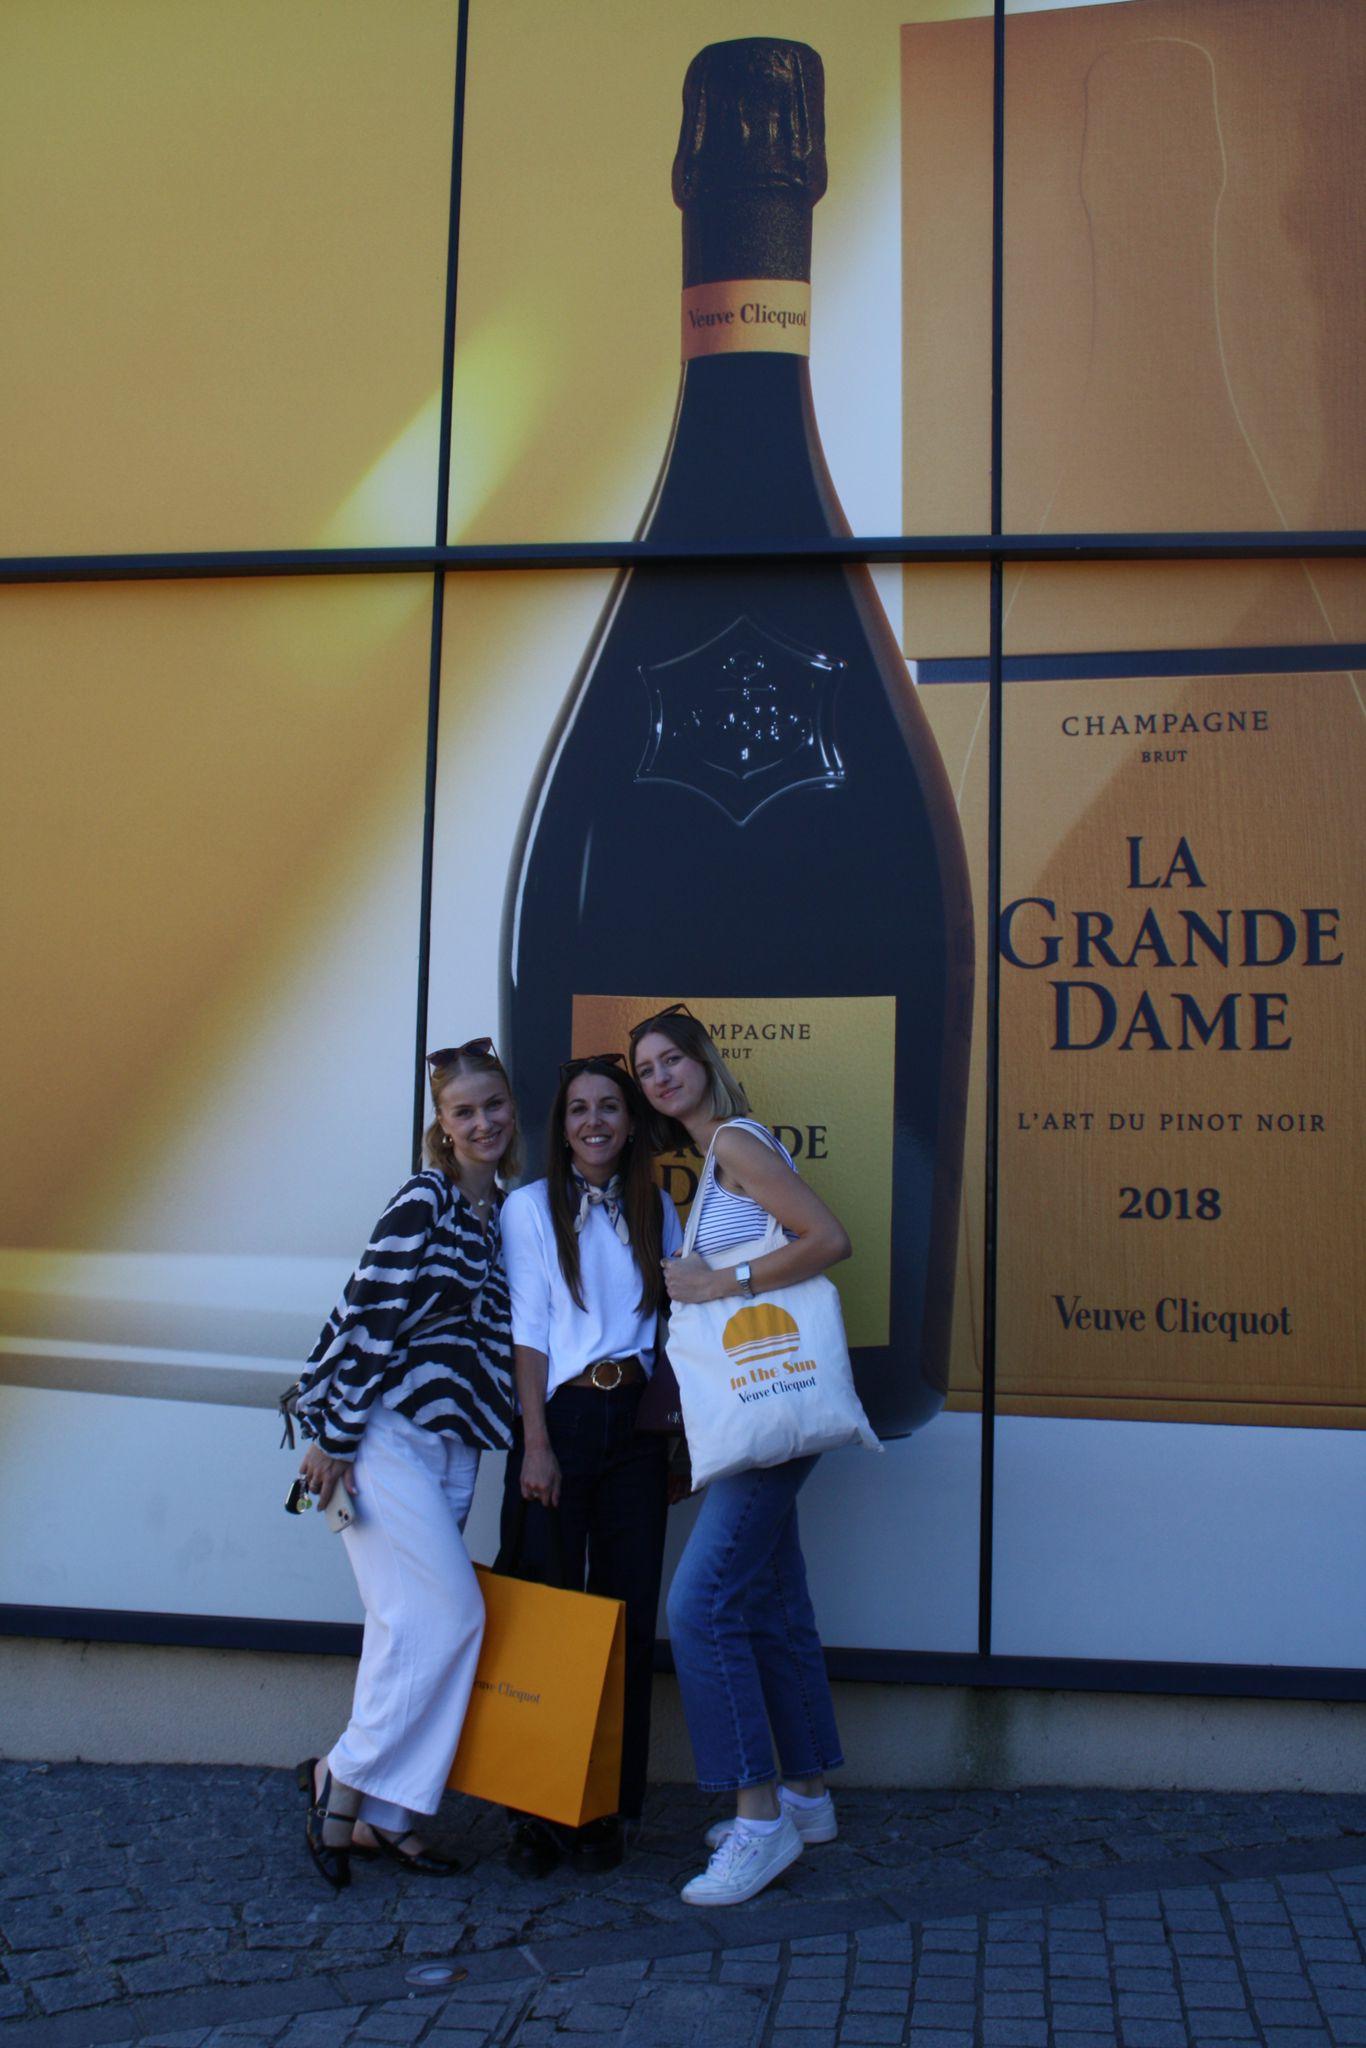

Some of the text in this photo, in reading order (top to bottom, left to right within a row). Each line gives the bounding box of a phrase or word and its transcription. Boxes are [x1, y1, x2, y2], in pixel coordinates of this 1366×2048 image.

[688, 303, 807, 328] Veuve Clicquot
[1061, 710, 1270, 737] CHAMPAGNE
[1141, 749, 1188, 764] BRUT
[1126, 835, 1207, 889] LA
[999, 896, 1344, 969] GRANDE
[1049, 980, 1292, 1052] DAME
[708, 1023, 811, 1040] MPAGNE
[720, 1047, 753, 1059] RUT
[1018, 1111, 1326, 1133] L'ART DU PINOT NOIR
[1118, 1186, 1222, 1221] 2018
[1051, 1294, 1294, 1343] Veuve Clicquot
[749, 1367, 779, 1384] the
[783, 1359, 817, 1375] Sun
[738, 1376, 817, 1404] Veuve Clicquot
[474, 1680, 496, 1691] euve
